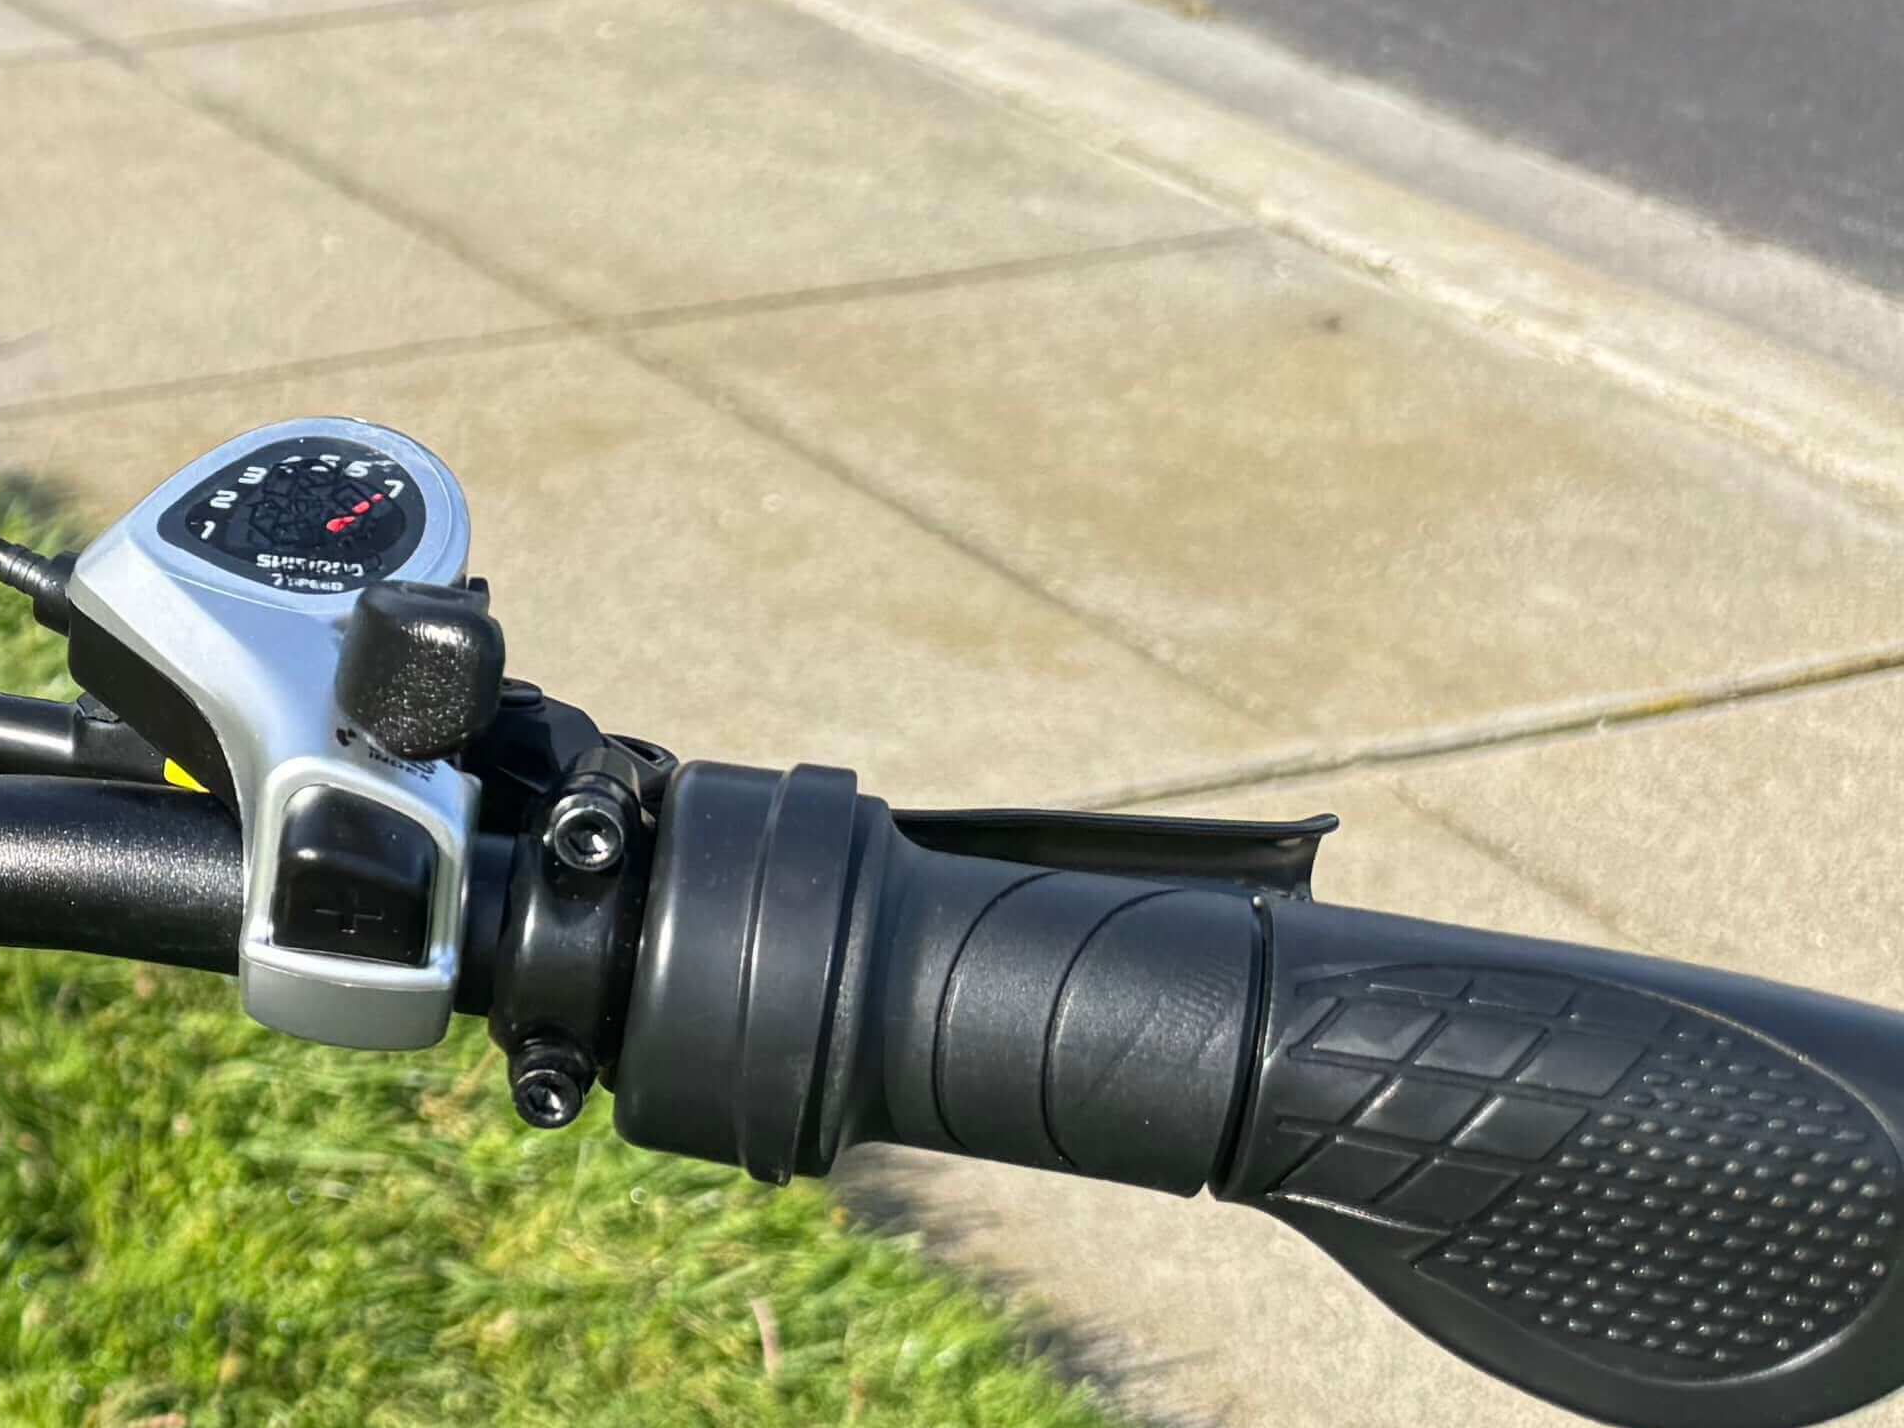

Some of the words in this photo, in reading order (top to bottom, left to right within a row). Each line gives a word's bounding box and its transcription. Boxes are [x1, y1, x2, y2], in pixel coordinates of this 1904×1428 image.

[200, 521, 216, 540] 1
[209, 489, 238, 509] 2
[238, 466, 268, 484] 3
[384, 479, 405, 499] 7
